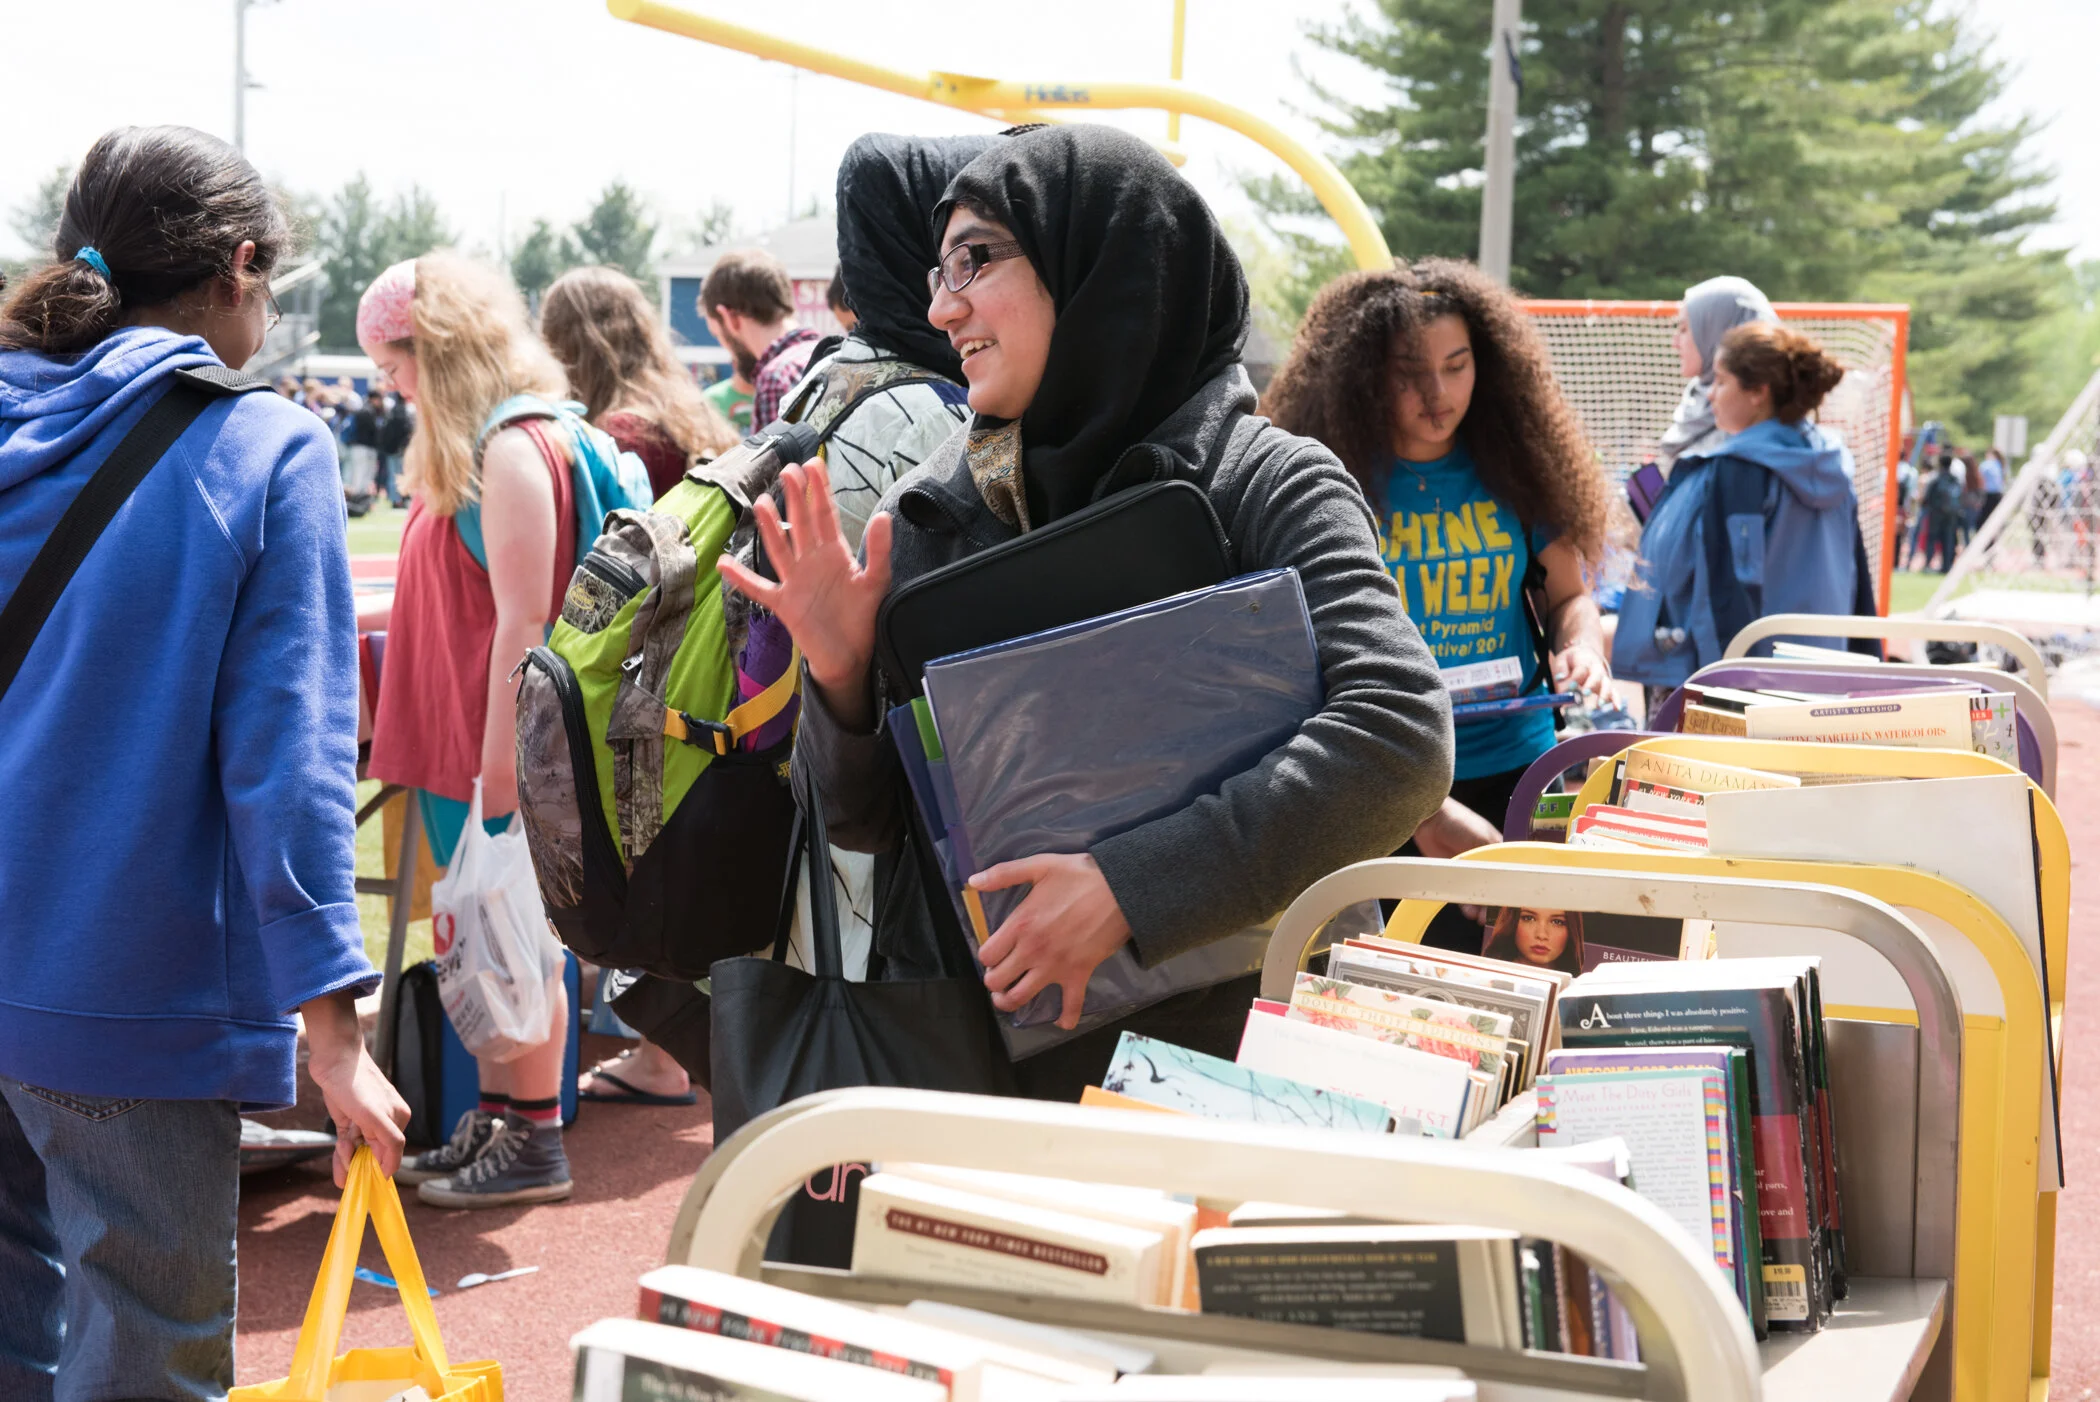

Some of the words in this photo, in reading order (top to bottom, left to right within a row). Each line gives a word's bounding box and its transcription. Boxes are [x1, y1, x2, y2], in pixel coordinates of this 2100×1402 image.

[1431, 616, 1495, 639] Pyramid
[1430, 641, 1473, 657] stival
[1814, 707, 1849, 716] ARTIST'S
[1852, 704, 1898, 713] WORKSHOP
[1815, 732, 1859, 743] STARTED
[1861, 728, 1872, 741] IN
[1874, 727, 1947, 741] WATERCOLORS
[1641, 758, 1692, 780] ANITA
[1701, 769, 1781, 789] DIAMA
[1602, 951, 1657, 962] BEAUTIF
[1624, 1011, 1641, 1019] three
[1643, 1009, 1664, 1019] things
[1665, 1008, 1670, 1017] I
[1684, 1007, 1718, 1017] absolutely
[1719, 1006, 1749, 1016] positive.
[1420, 1022, 1493, 1048] EDITIONS
[1647, 1025, 1671, 1033] Edward
[1682, 1038, 1695, 1046] part
[1563, 1089, 1596, 1103] Meet
[1601, 1086, 1621, 1101] The
[1662, 1083, 1692, 1098] Girls
[1777, 1206, 1794, 1216] and
